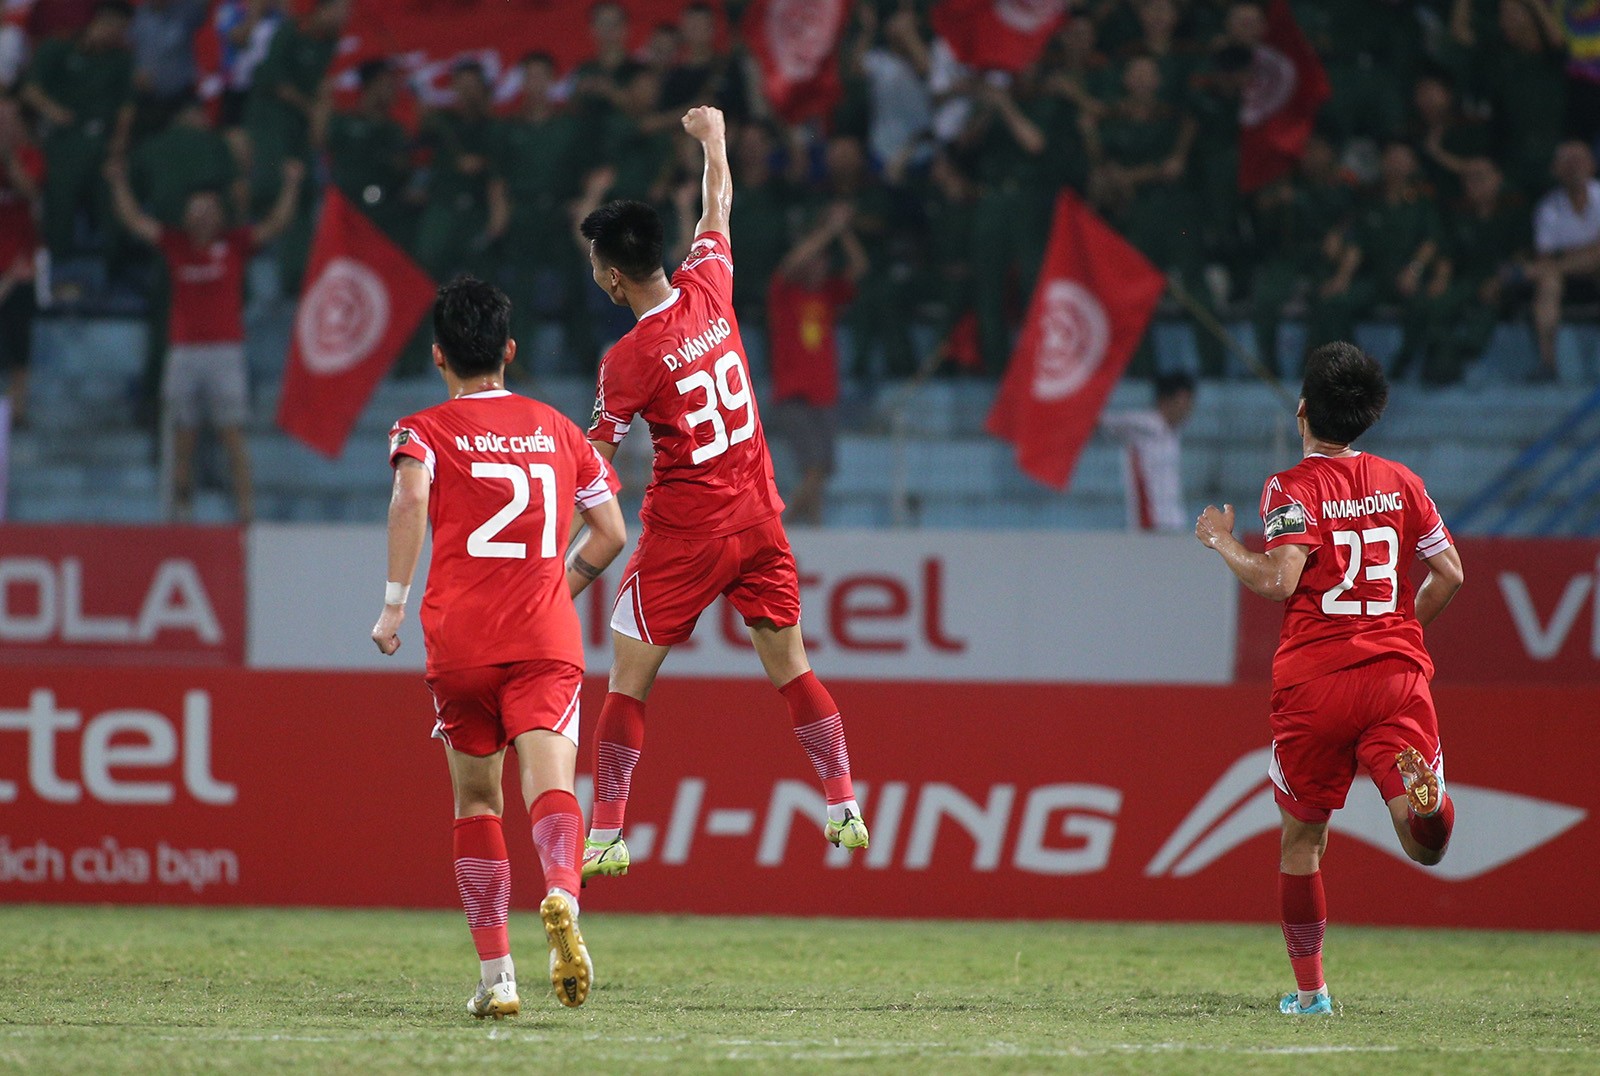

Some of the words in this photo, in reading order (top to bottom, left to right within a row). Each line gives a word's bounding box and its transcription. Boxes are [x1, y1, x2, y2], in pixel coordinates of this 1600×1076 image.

[662, 353, 682, 372] D.
[703, 317, 731, 349] HÀO
[454, 434, 474, 452] N.
[675, 350, 755, 466] 39
[466, 462, 557, 559] 21
[0, 556, 223, 645] OLA
[1321, 526, 1399, 615] 23
[0, 688, 238, 804] tel
